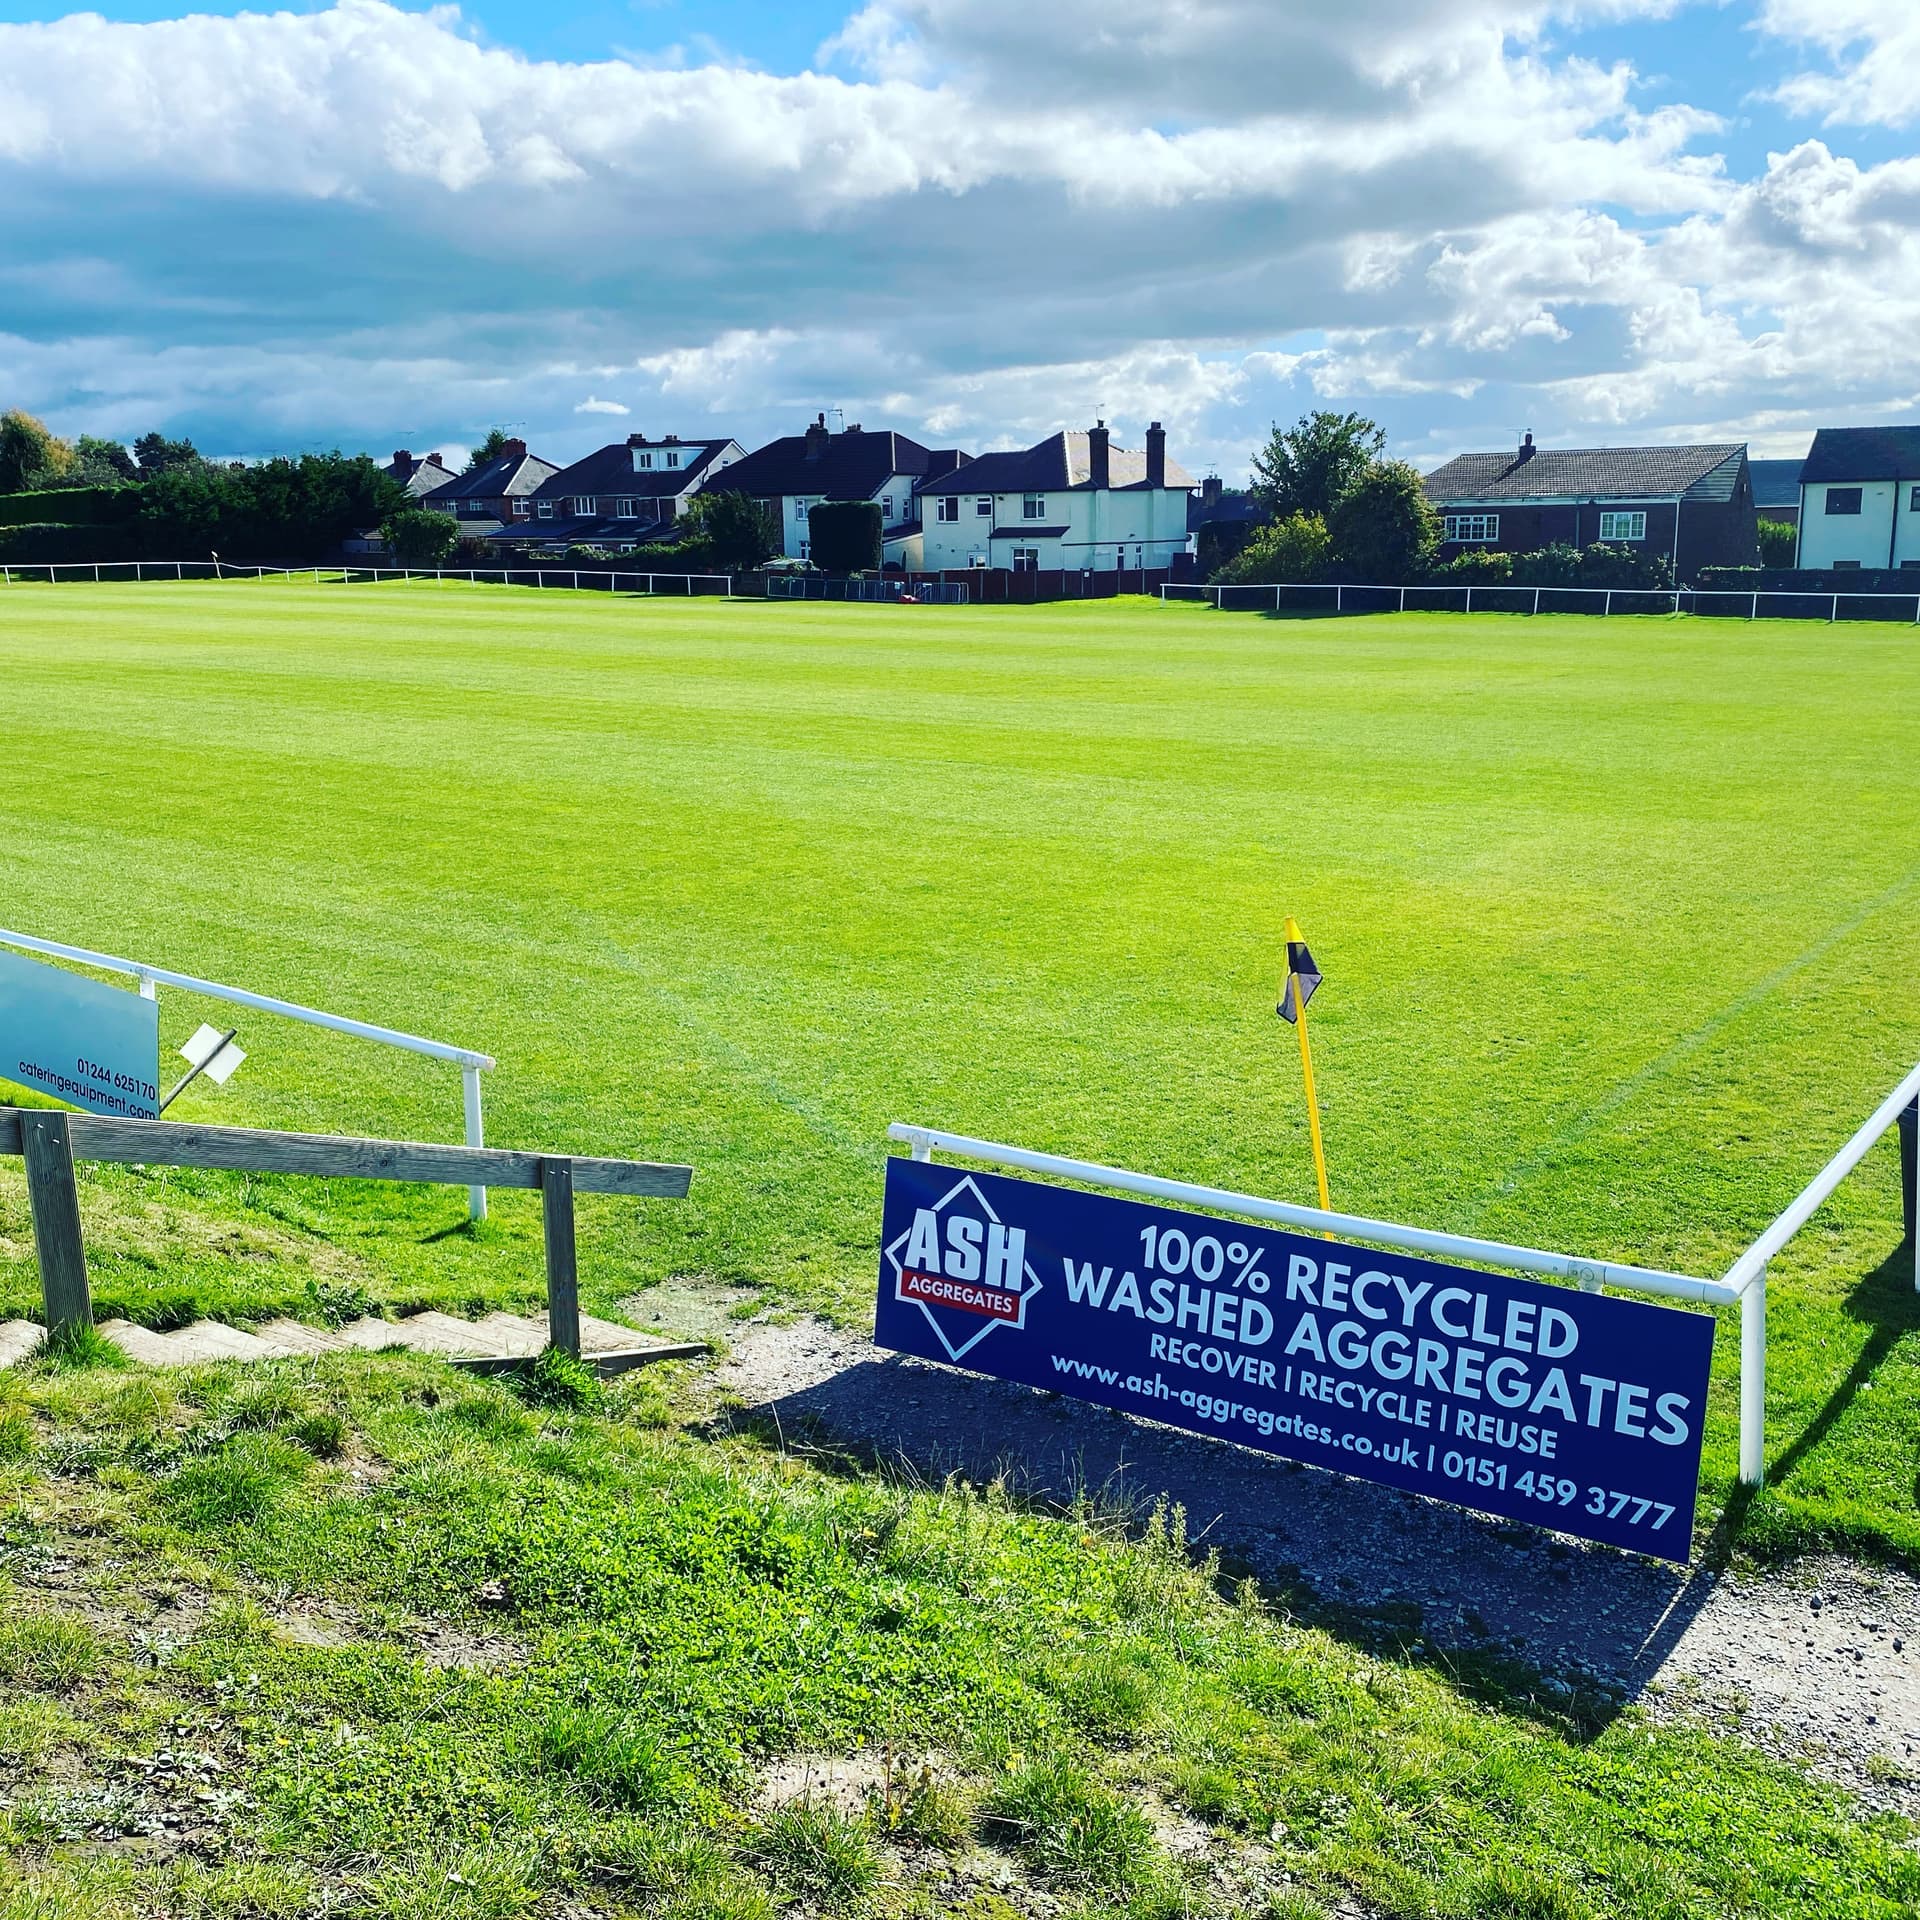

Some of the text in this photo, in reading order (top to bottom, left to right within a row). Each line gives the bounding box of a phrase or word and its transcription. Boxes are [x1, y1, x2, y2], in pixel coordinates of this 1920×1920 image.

[19, 1061, 156, 1120] cateringequipment.com
[77, 1058, 156, 1101] 01244 625170
[904, 1208, 1026, 1292] ASH
[908, 1276, 1013, 1313] AGGREGATES
[1140, 1225, 1579, 1359] 100% RECYCLED
[1062, 1257, 1691, 1446] WASHED AGGREGATES
[1150, 1333, 1277, 1390] RECOVER
[1299, 1370, 1432, 1428] RECYCLE
[1455, 1408, 1558, 1459] REUSE
[1051, 1355, 1419, 1469] www.ash-aggregates.co.uk
[1442, 1450, 1508, 1491] 0151
[1513, 1470, 1577, 1506] 459
[1585, 1486, 1676, 1530] 3777
